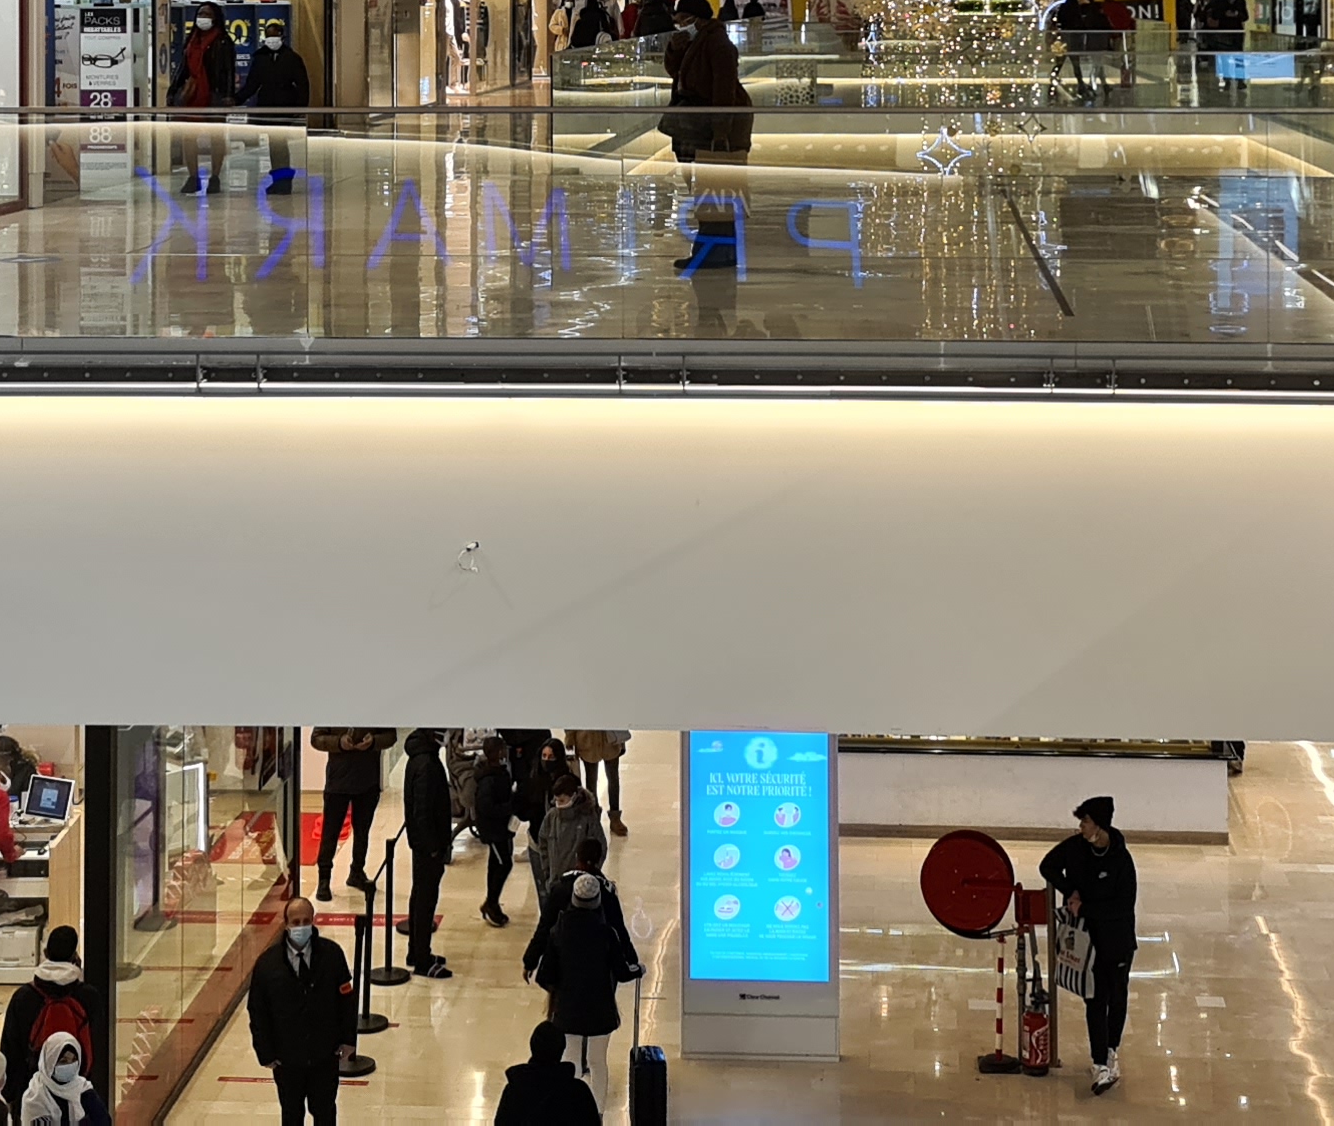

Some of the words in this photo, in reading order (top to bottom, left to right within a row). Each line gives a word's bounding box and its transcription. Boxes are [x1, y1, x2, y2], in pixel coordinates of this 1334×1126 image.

[84, 17, 121, 26] PACKS
[89, 92, 112, 108] 28
[89, 126, 112, 144] 88
[726, 772, 758, 784] VOTRE
[760, 771, 807, 785] SÉCURITÉ
[706, 785, 725, 796] EST
[727, 785, 760, 796] NOTRE
[762, 783, 807, 797] PRIORITÉ
